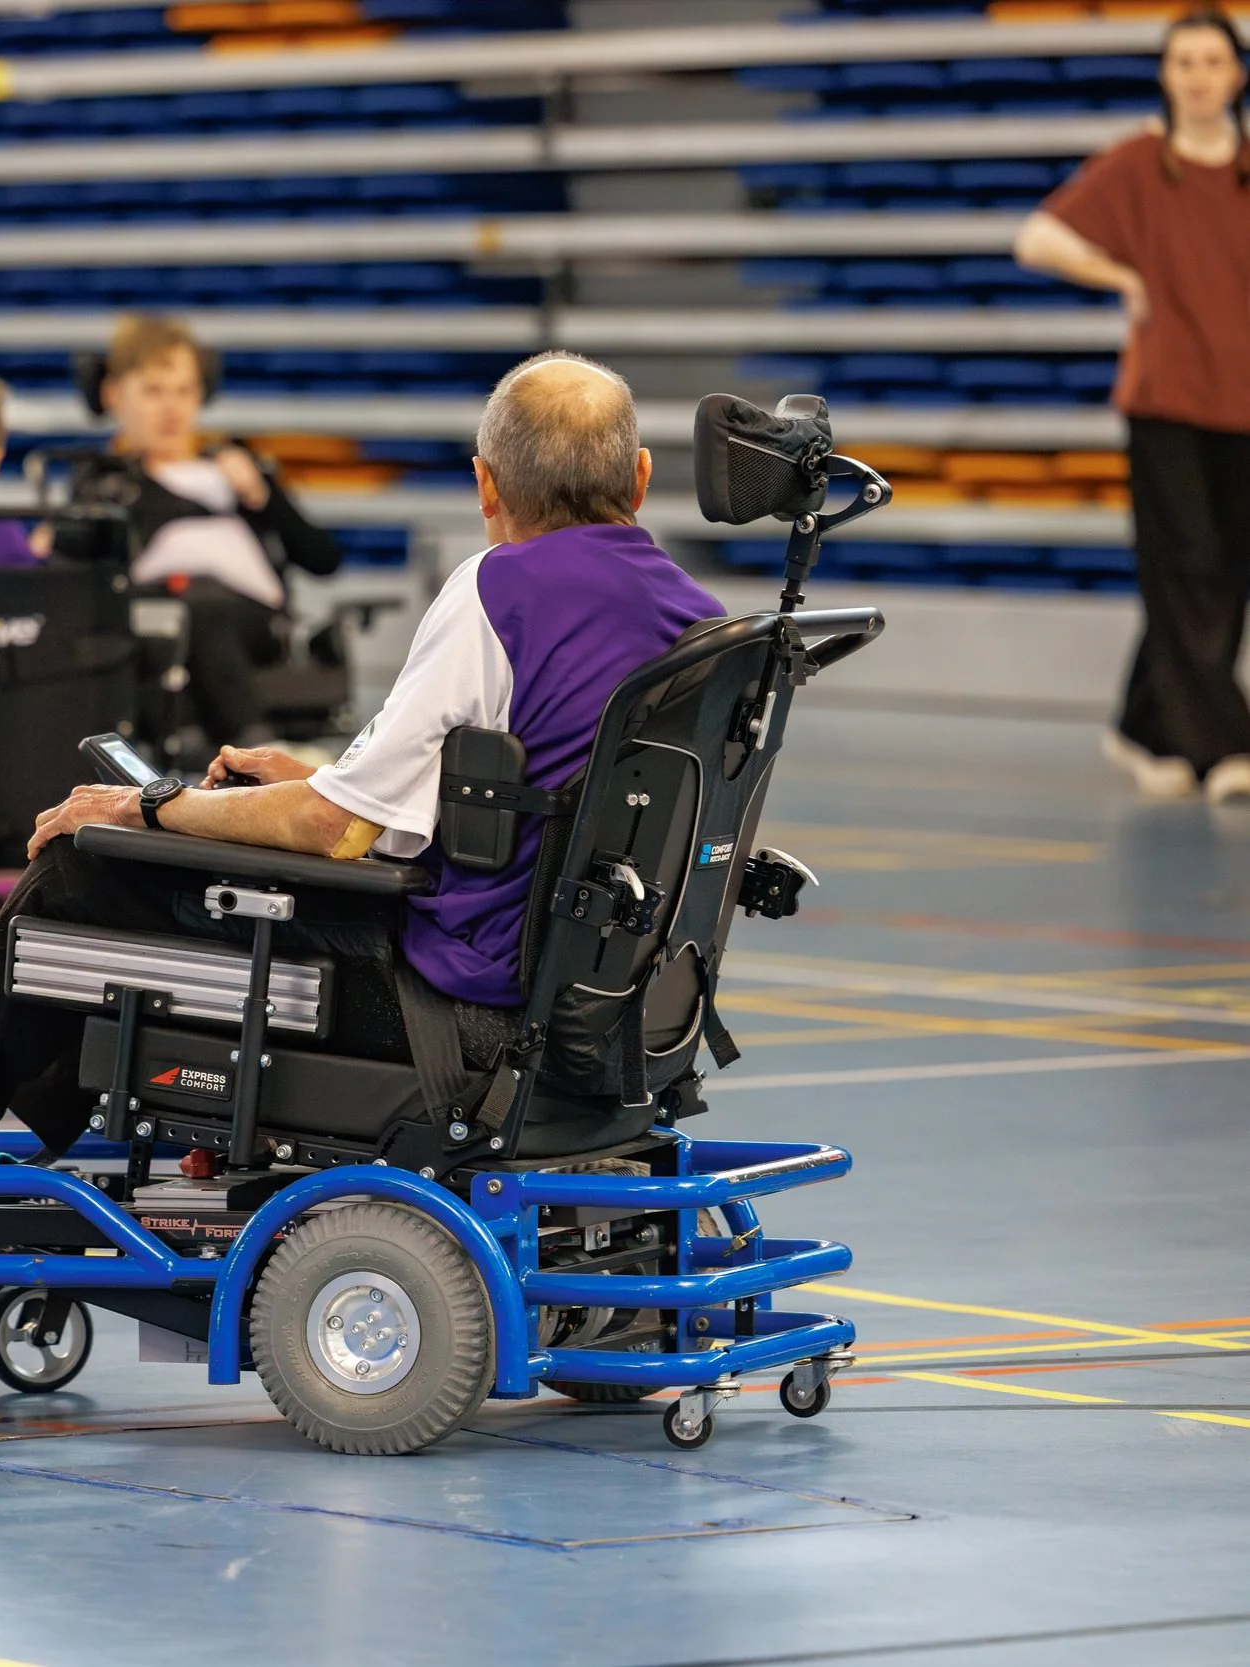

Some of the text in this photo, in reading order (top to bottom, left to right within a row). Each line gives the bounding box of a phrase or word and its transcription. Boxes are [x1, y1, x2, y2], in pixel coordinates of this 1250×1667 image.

[181, 1069, 226, 1084] EXPRESS
[180, 1079, 225, 1092] COMFORT
[205, 1227, 240, 1238] FORC
